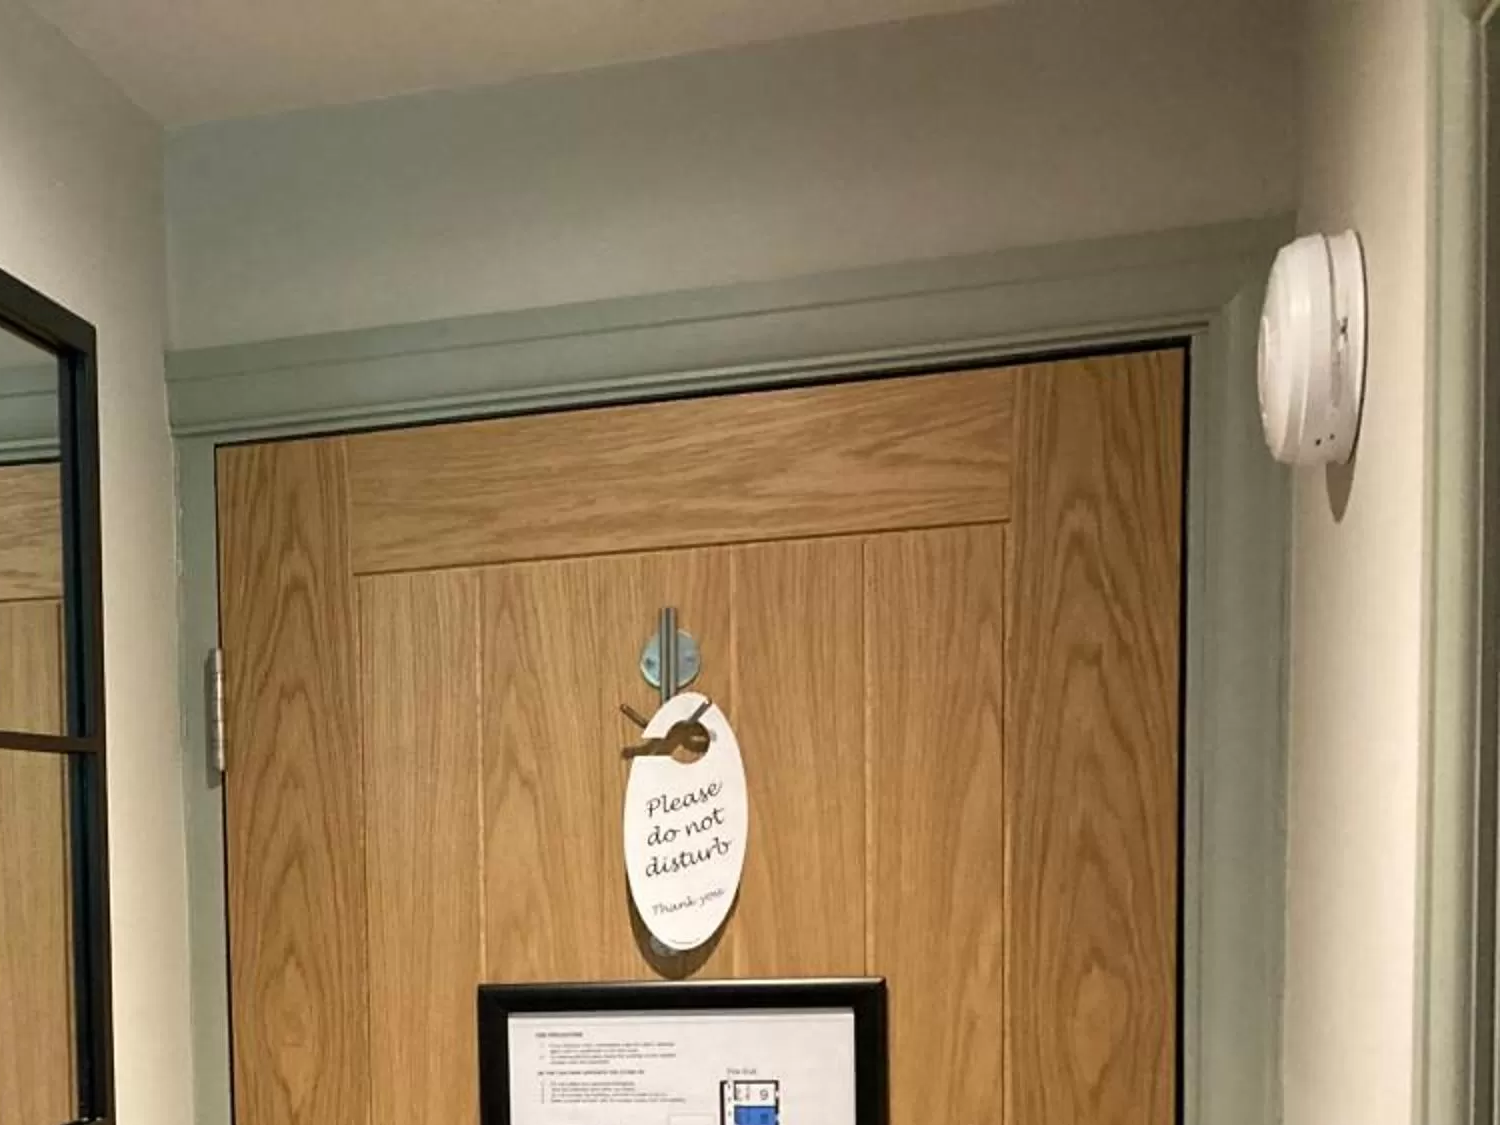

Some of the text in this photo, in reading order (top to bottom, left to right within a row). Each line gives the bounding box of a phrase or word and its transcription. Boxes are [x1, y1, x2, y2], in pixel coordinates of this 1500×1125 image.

[646, 780, 723, 818] Please
[647, 808, 725, 847] do not
[645, 838, 732, 878] disturb
[651, 888, 725, 917] Thank you
[760, 1089, 769, 1101] 9
